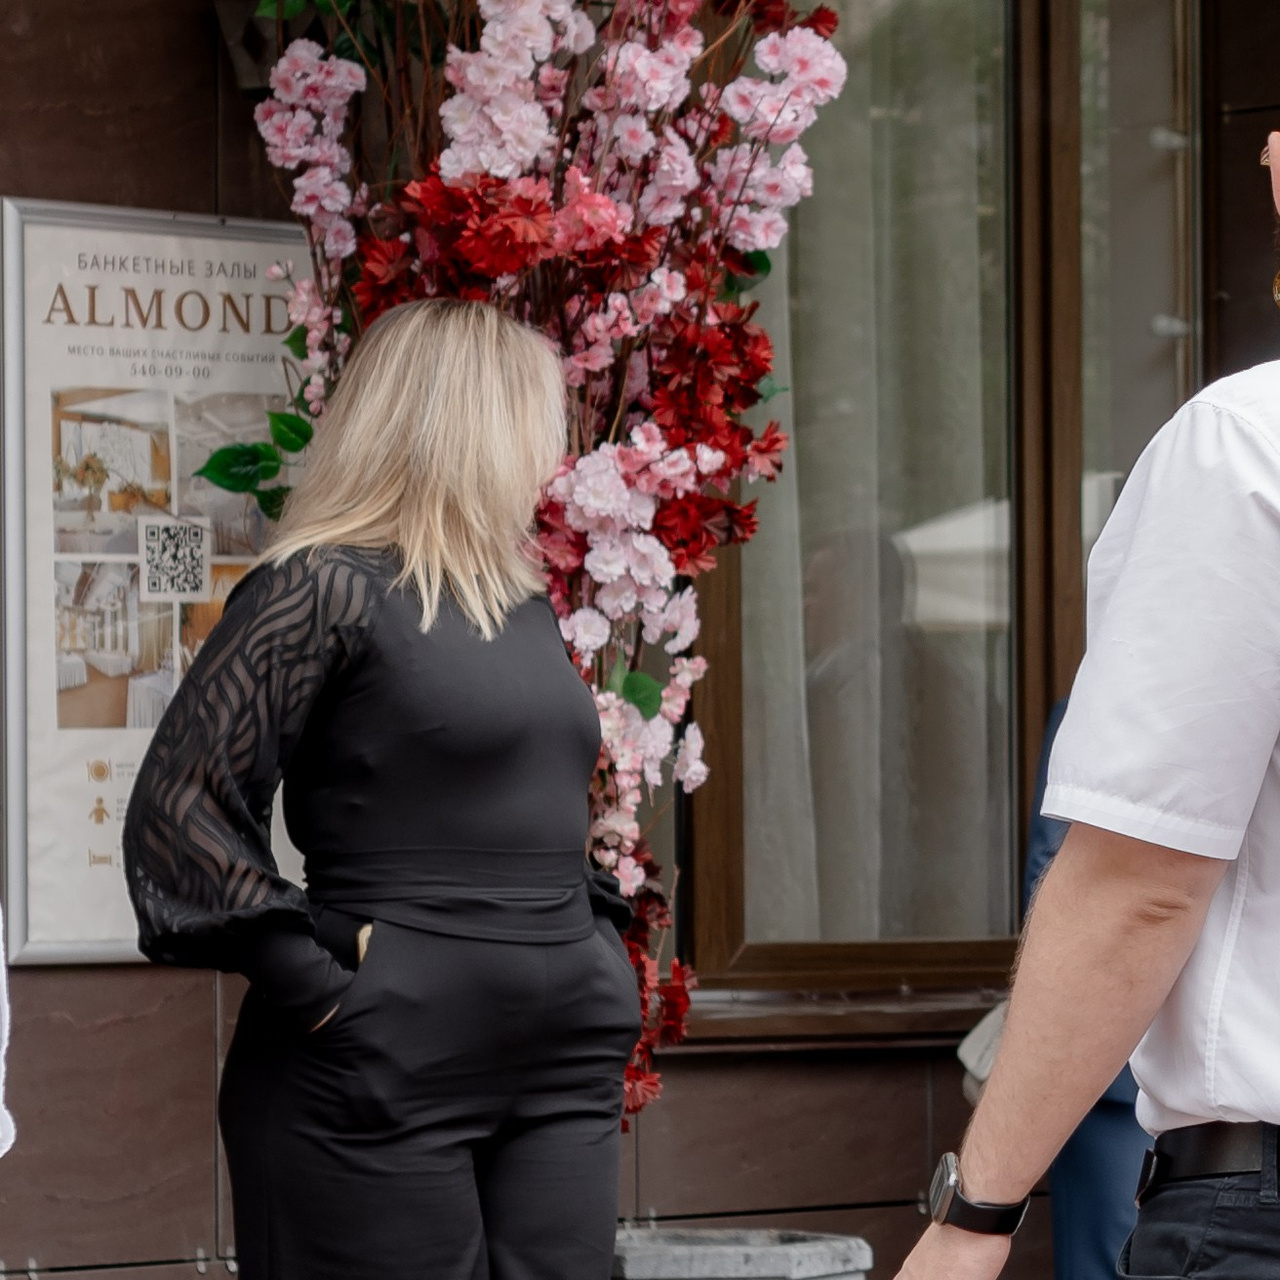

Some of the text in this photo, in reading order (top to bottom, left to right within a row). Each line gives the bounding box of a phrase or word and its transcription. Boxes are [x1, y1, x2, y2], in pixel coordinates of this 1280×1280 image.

[78, 252, 257, 279] БАНКЕТНЫЕ ЗАЛЫ
[42, 282, 294, 335] ALMOND
[67, 345, 276, 363] МЕСТО ВАШИХ СЧАСТЛИВЫХ СОБЫТИЙ
[130, 363, 211, 379] 540-09-00
